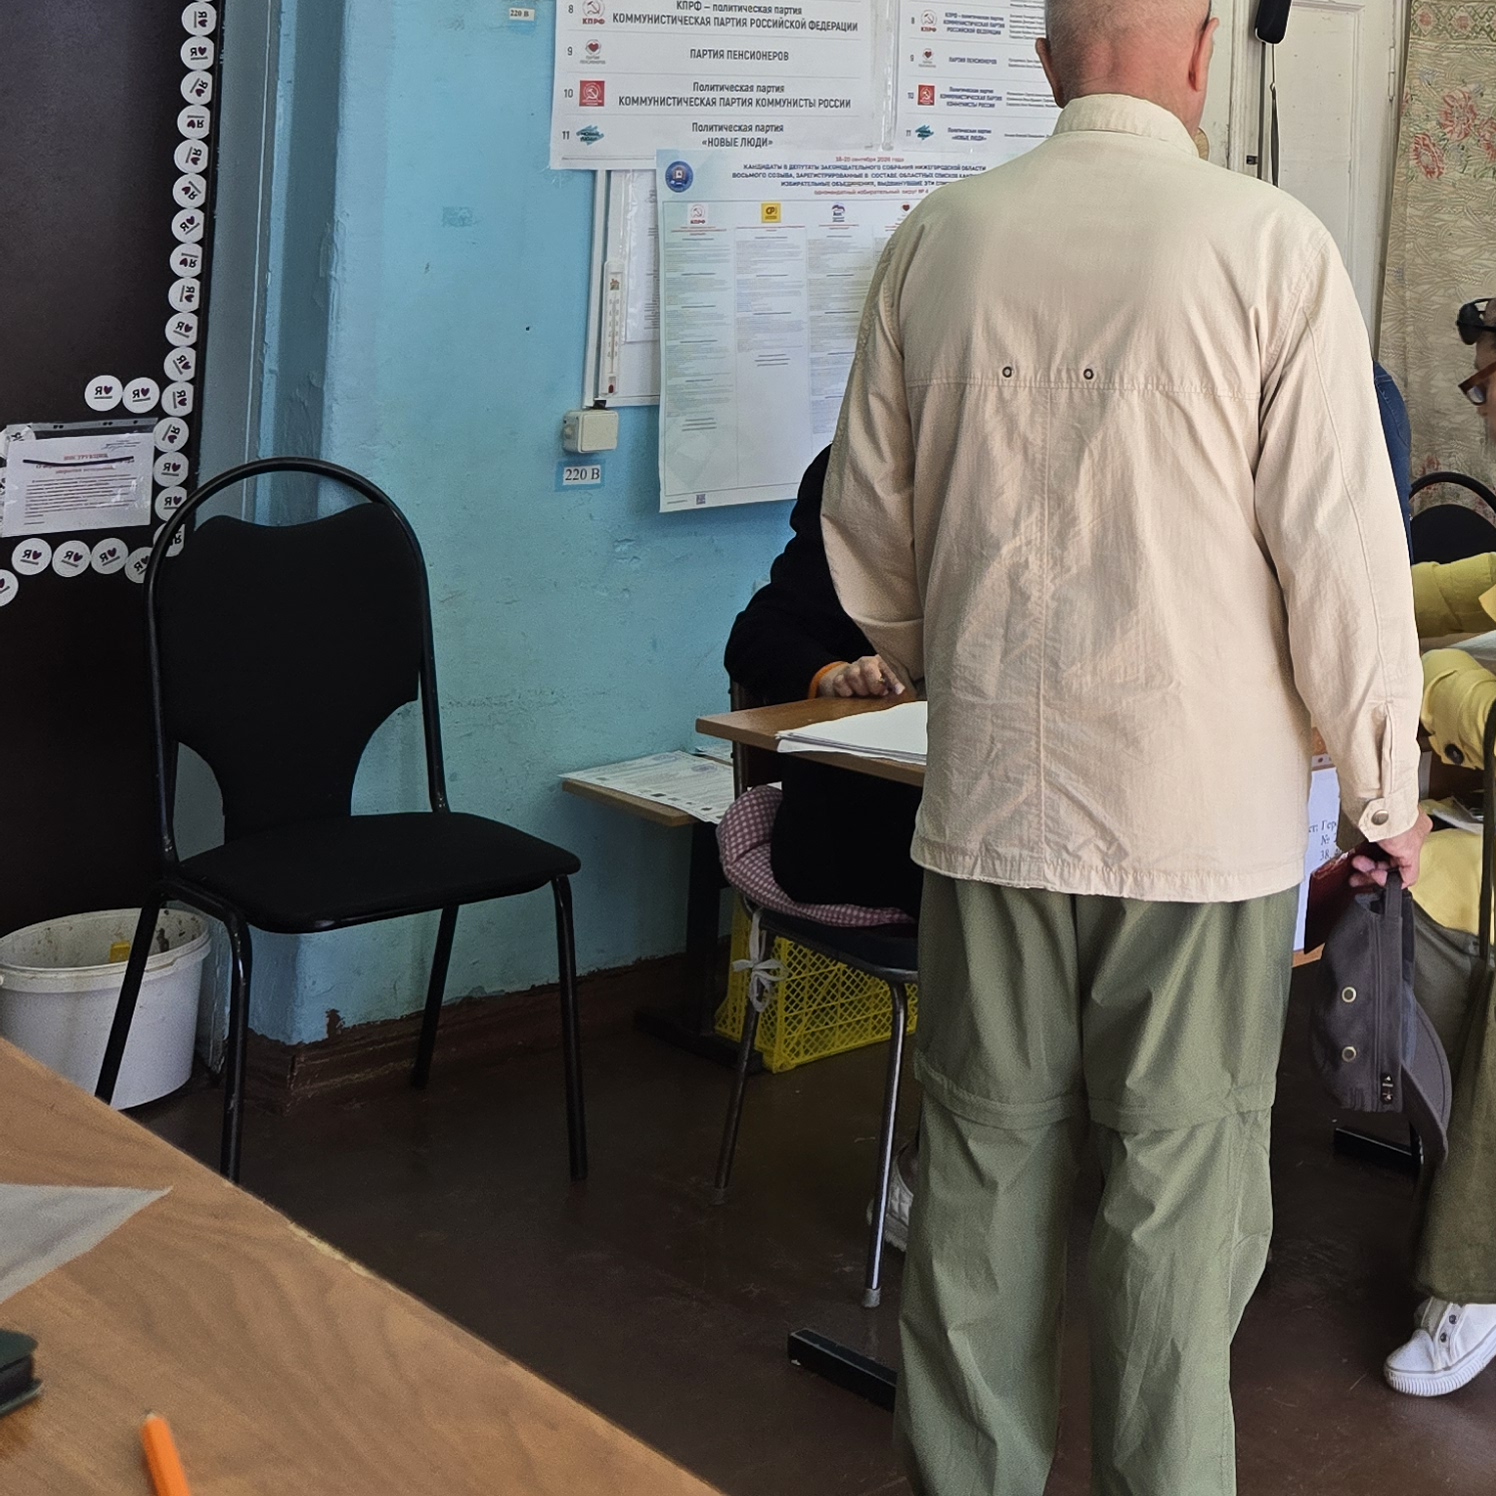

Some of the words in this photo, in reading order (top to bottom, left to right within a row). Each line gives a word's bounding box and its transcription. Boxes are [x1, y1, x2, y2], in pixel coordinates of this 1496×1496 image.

[569, 4, 573, 13] 8
[676, 0, 702, 11] КПРФ
[712, 2, 771, 16] политическая
[774, 6, 802, 17] партия
[582, 17, 605, 25] КПРФ
[613, 13, 711, 27] КОММУНИСТИЧЕСКАЯ
[714, 17, 747, 28] ПАРТИЯ
[750, 17, 806, 31] РОССИЙСКОЙ
[808, 20, 858, 32] ФЕДЕРАЦИИ
[190, 48, 197, 57] Я
[567, 47, 572, 56] 9
[690, 49, 724, 60] ПАРТИЯ
[726, 49, 789, 61] ПЕНСИОНЕРОВ
[564, 89, 573, 98] 10
[693, 82, 754, 94] Политическая
[756, 84, 784, 96] партия
[619, 95, 716, 107] КОММУНИСТИЧЕСКАЯ
[719, 97, 752, 107] ПАРТИЯ
[755, 97, 816, 108] КОММУНИСТЫ
[818, 98, 851, 109] РОССИИ
[692, 122, 753, 134] Политическая
[755, 124, 784, 136] партия
[562, 131, 570, 140] 11
[702, 137, 738, 148] «НОВЫЕ
[740, 137, 773, 149] ЛЮДИ»
[95, 386, 102, 395] Я
[132, 390, 140, 398] Я
[565, 468, 587, 480] 220
[591, 468, 600, 479] В
[23, 549, 31, 559] Я
[64, 551, 72, 560] Я
[100, 554, 108, 562] Я
